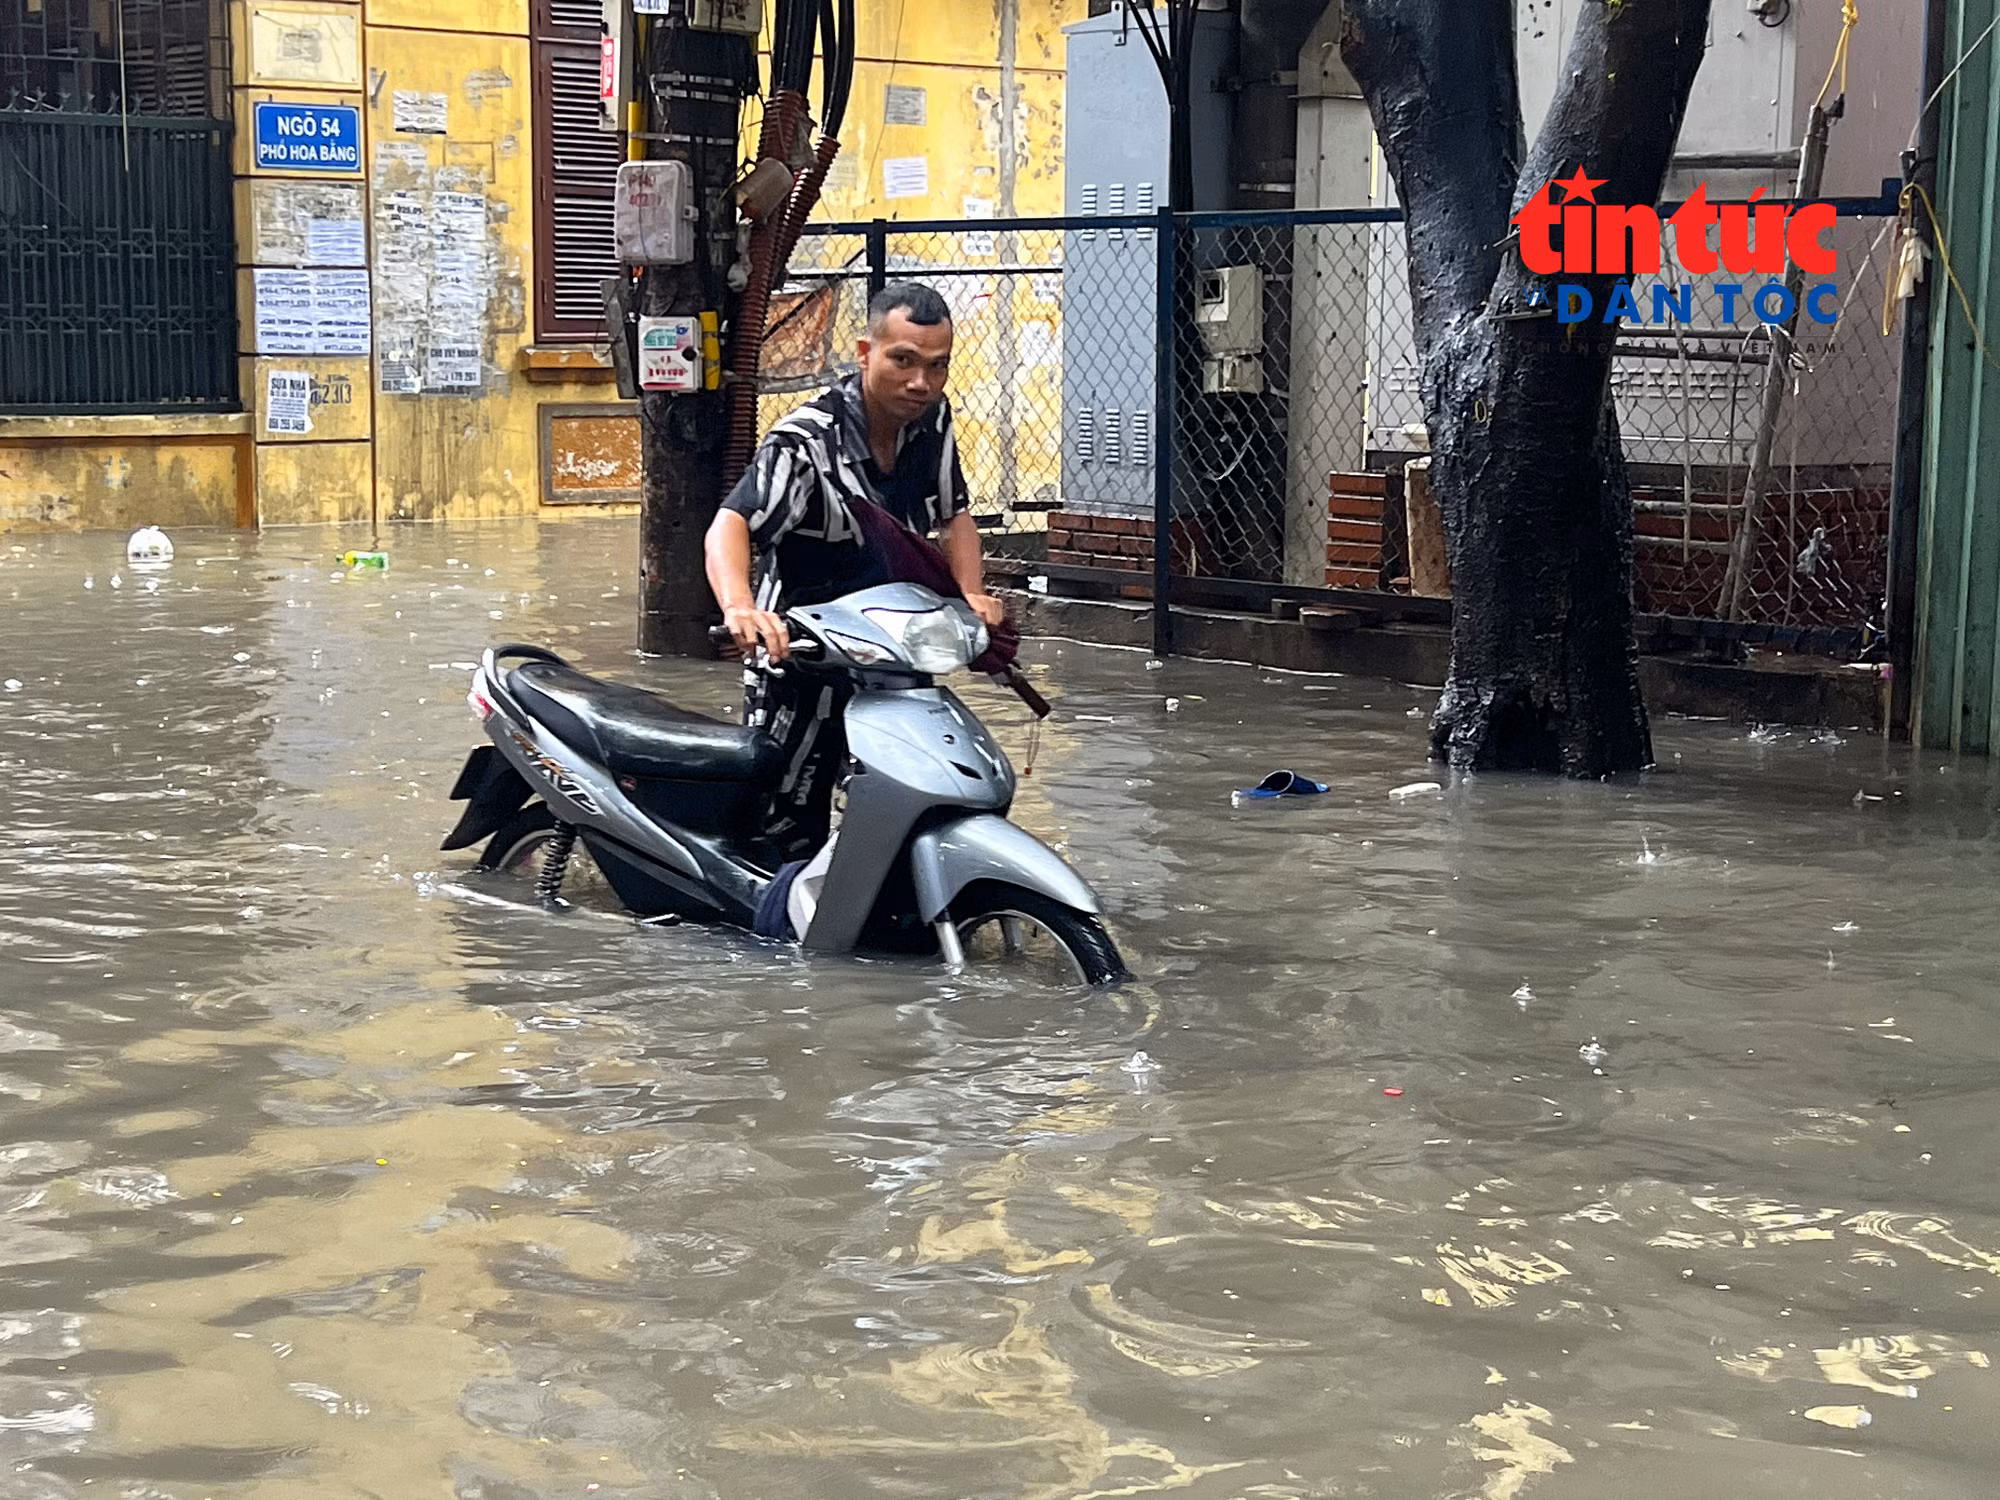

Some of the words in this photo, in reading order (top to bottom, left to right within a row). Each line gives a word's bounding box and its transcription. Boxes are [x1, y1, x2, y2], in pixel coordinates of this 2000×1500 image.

[277, 110, 317, 137] NGÕ
[320, 117, 341, 137] 54
[260, 138, 287, 160] PHỐ
[289, 144, 319, 160] HOA
[319, 138, 356, 162] BẰNG
